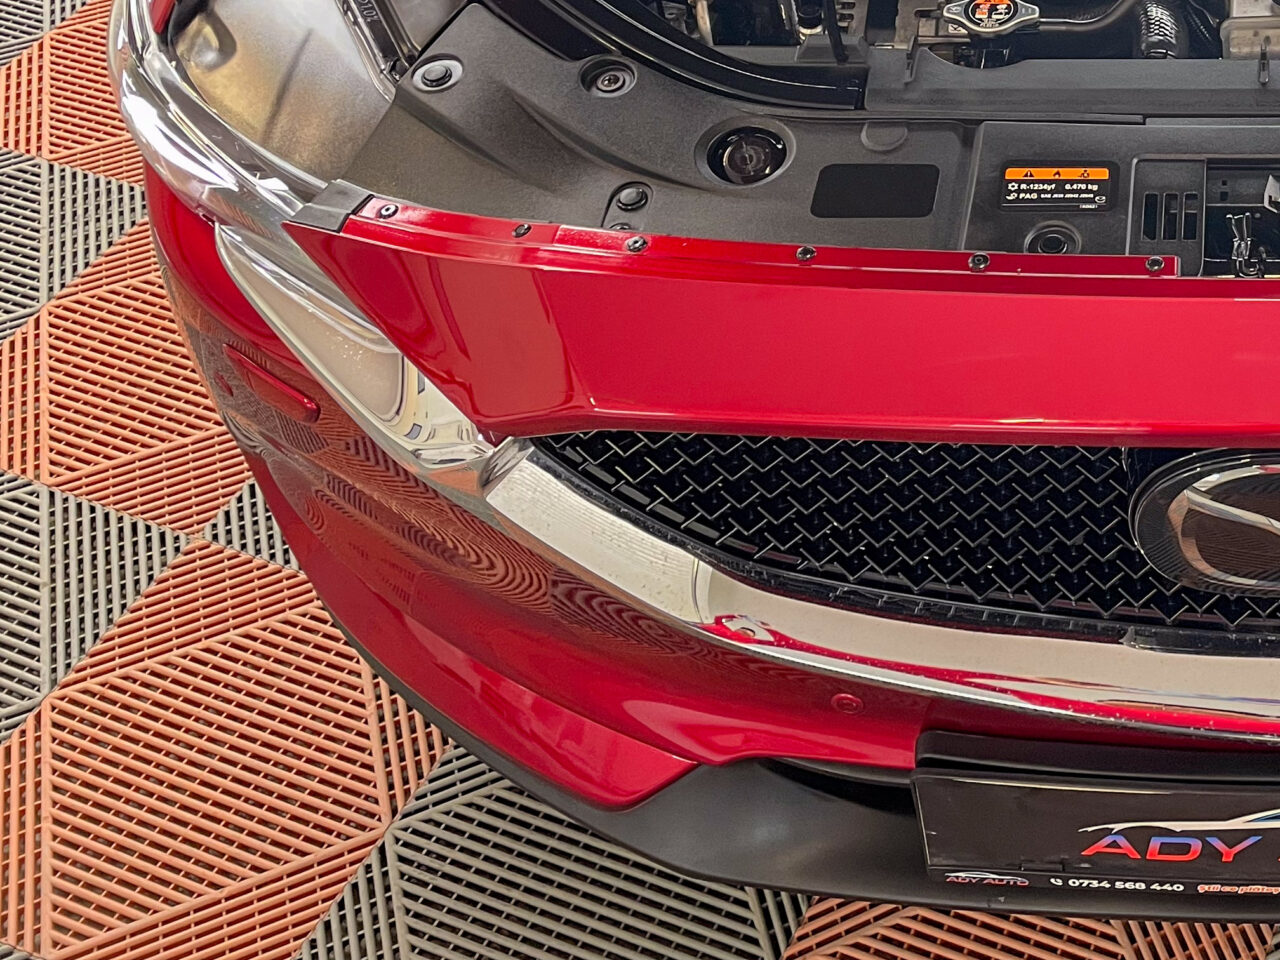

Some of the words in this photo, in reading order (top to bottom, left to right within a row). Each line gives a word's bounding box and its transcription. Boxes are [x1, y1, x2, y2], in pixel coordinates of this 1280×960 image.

[1020, 183, 1056, 191] R-1234yf
[1087, 183, 1098, 191] kg
[1081, 834, 1262, 862] ADY
[945, 875, 980, 884] ADY
[983, 877, 1029, 886] AUTO
[1068, 878, 1111, 889] 0734
[1114, 880, 1146, 890] 568
[1150, 882, 1184, 892] 440
